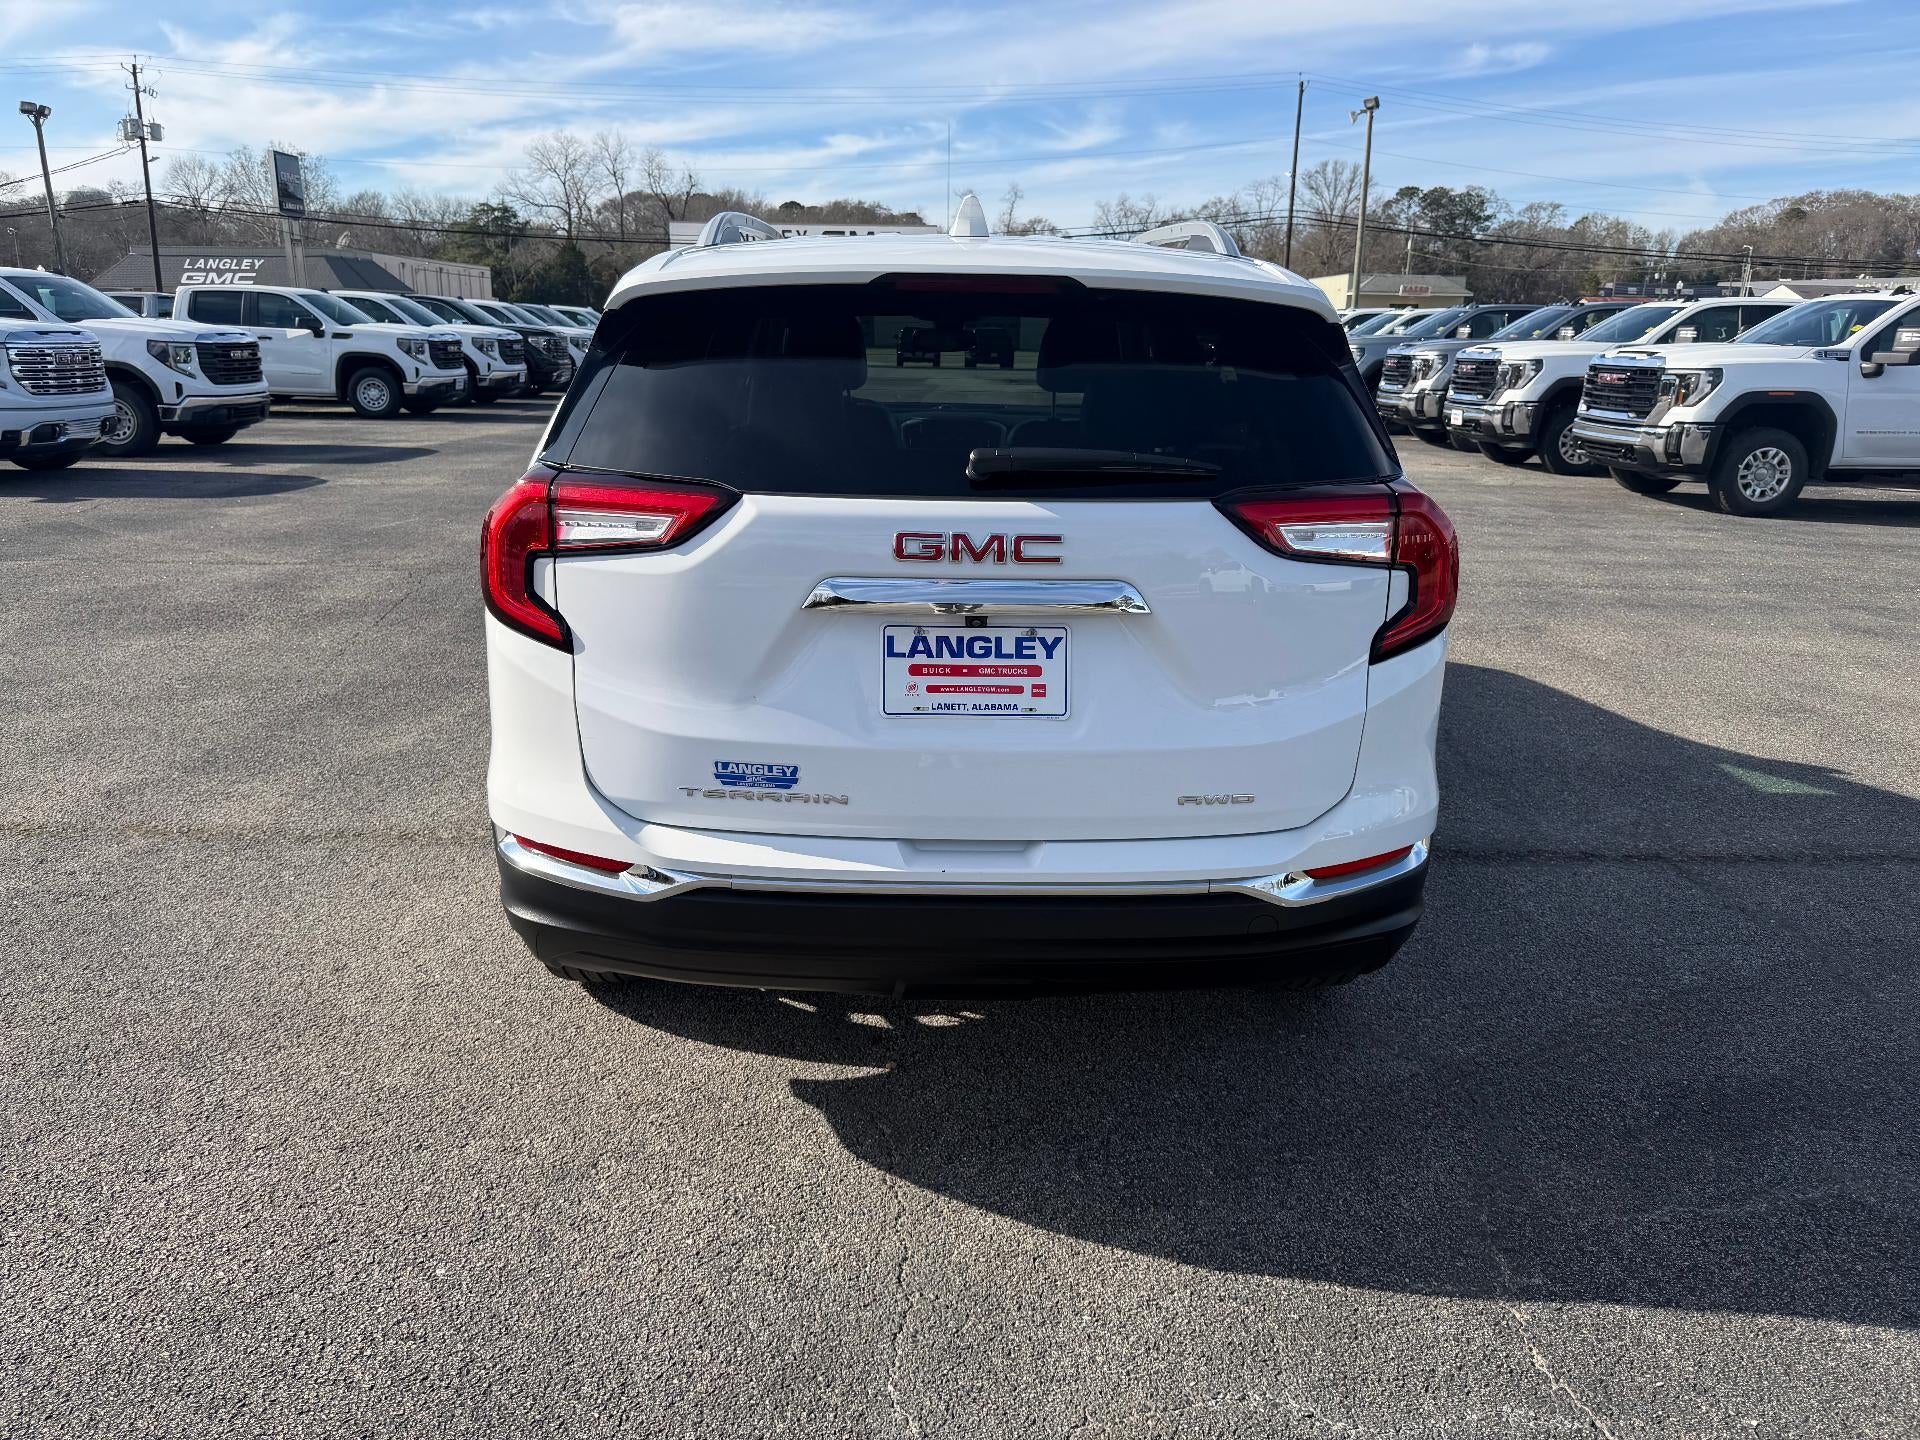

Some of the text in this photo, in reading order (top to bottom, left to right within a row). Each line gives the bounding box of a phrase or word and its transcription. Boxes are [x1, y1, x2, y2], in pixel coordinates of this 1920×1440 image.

[183, 258, 264, 269] LANGLEY
[180, 272, 256, 284] GMC
[893, 531, 1064, 564] GMC
[886, 635, 1064, 659] LANGLEY
[978, 667, 996, 675] GMC
[931, 702, 1019, 712] LANETT, ALABAMA
[717, 761, 795, 777] LANGLEY
[678, 786, 849, 805] TERRAIN
[1177, 793, 1255, 806] AWD
